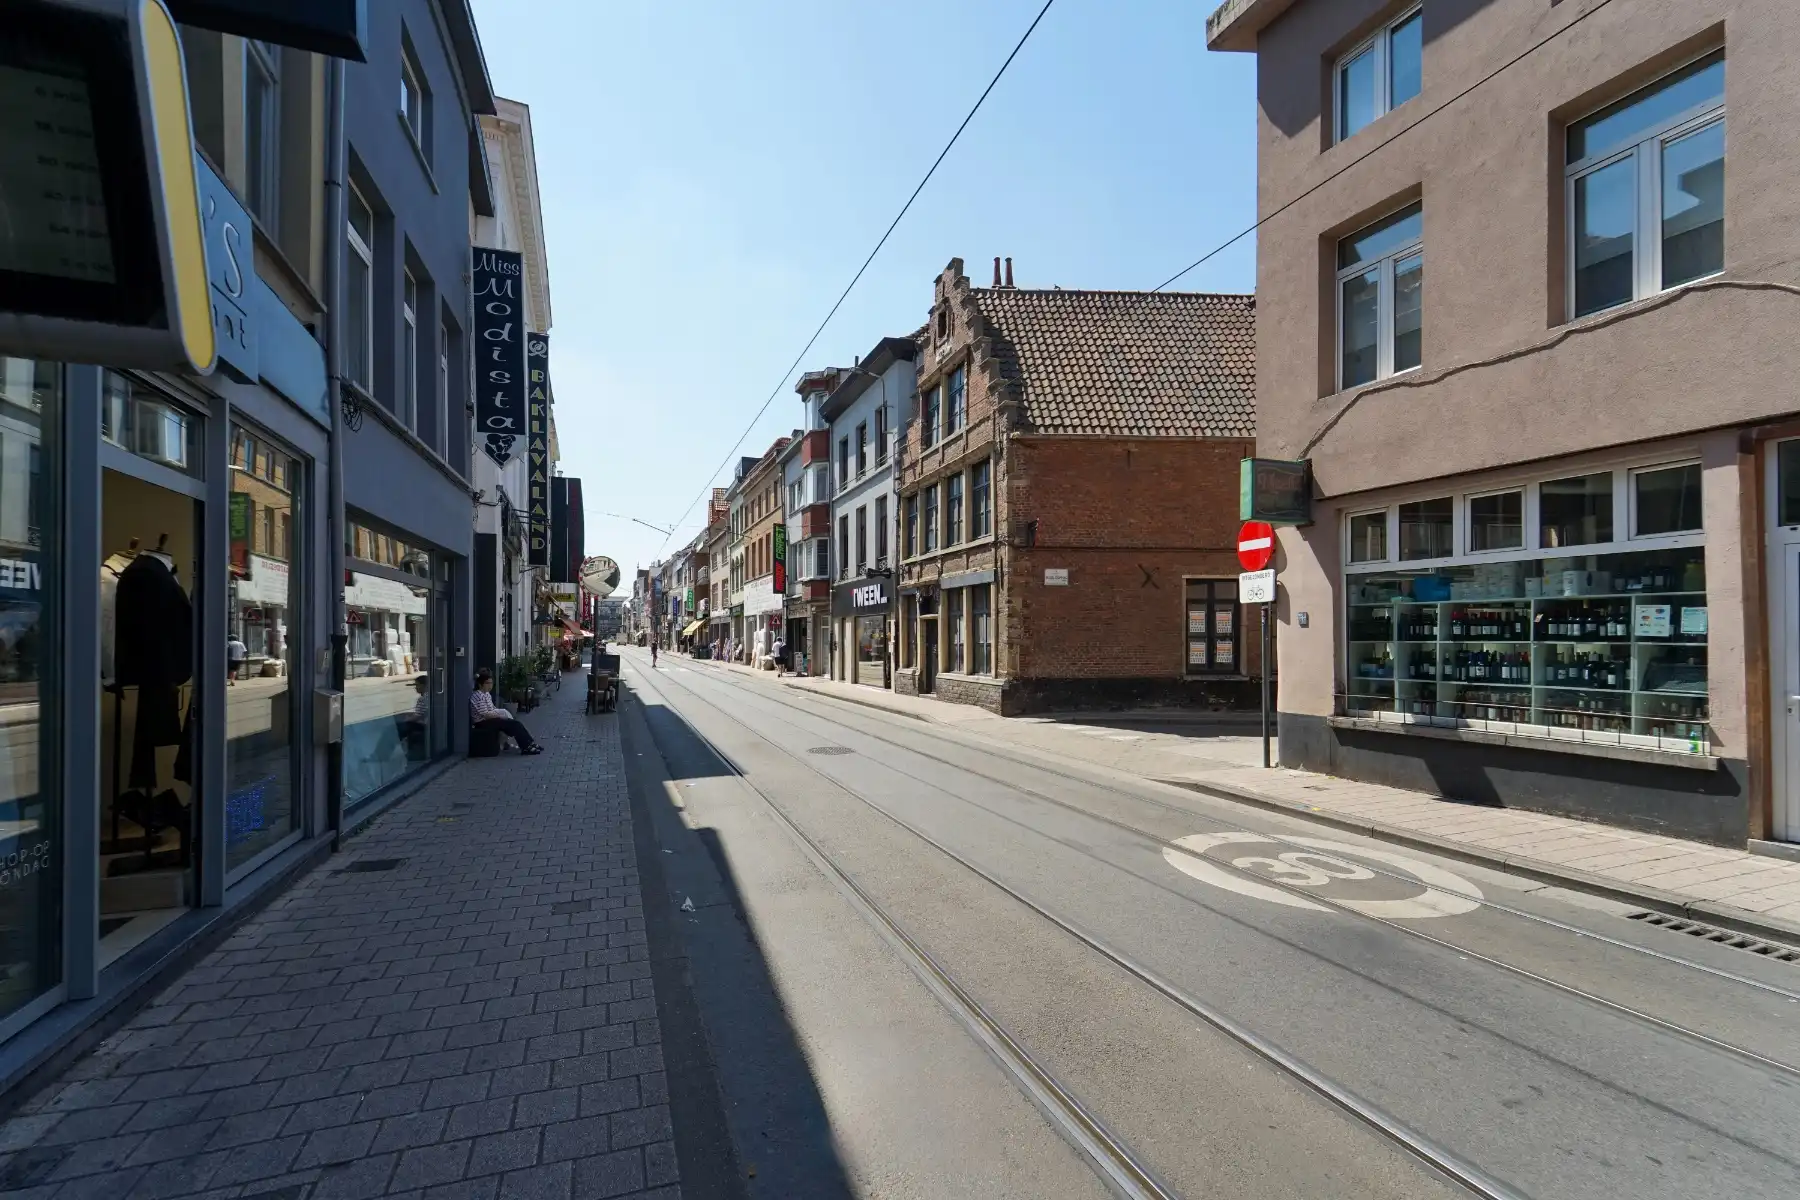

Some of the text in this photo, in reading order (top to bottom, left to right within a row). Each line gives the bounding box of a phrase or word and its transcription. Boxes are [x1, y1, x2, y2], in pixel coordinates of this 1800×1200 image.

[473, 252, 521, 276] Miss
[473, 277, 517, 430] Modista
[530, 369, 546, 550] BAKLAVALAND
[775, 525, 785, 560] CARPET
[1232, 852, 1375, 886] 30
